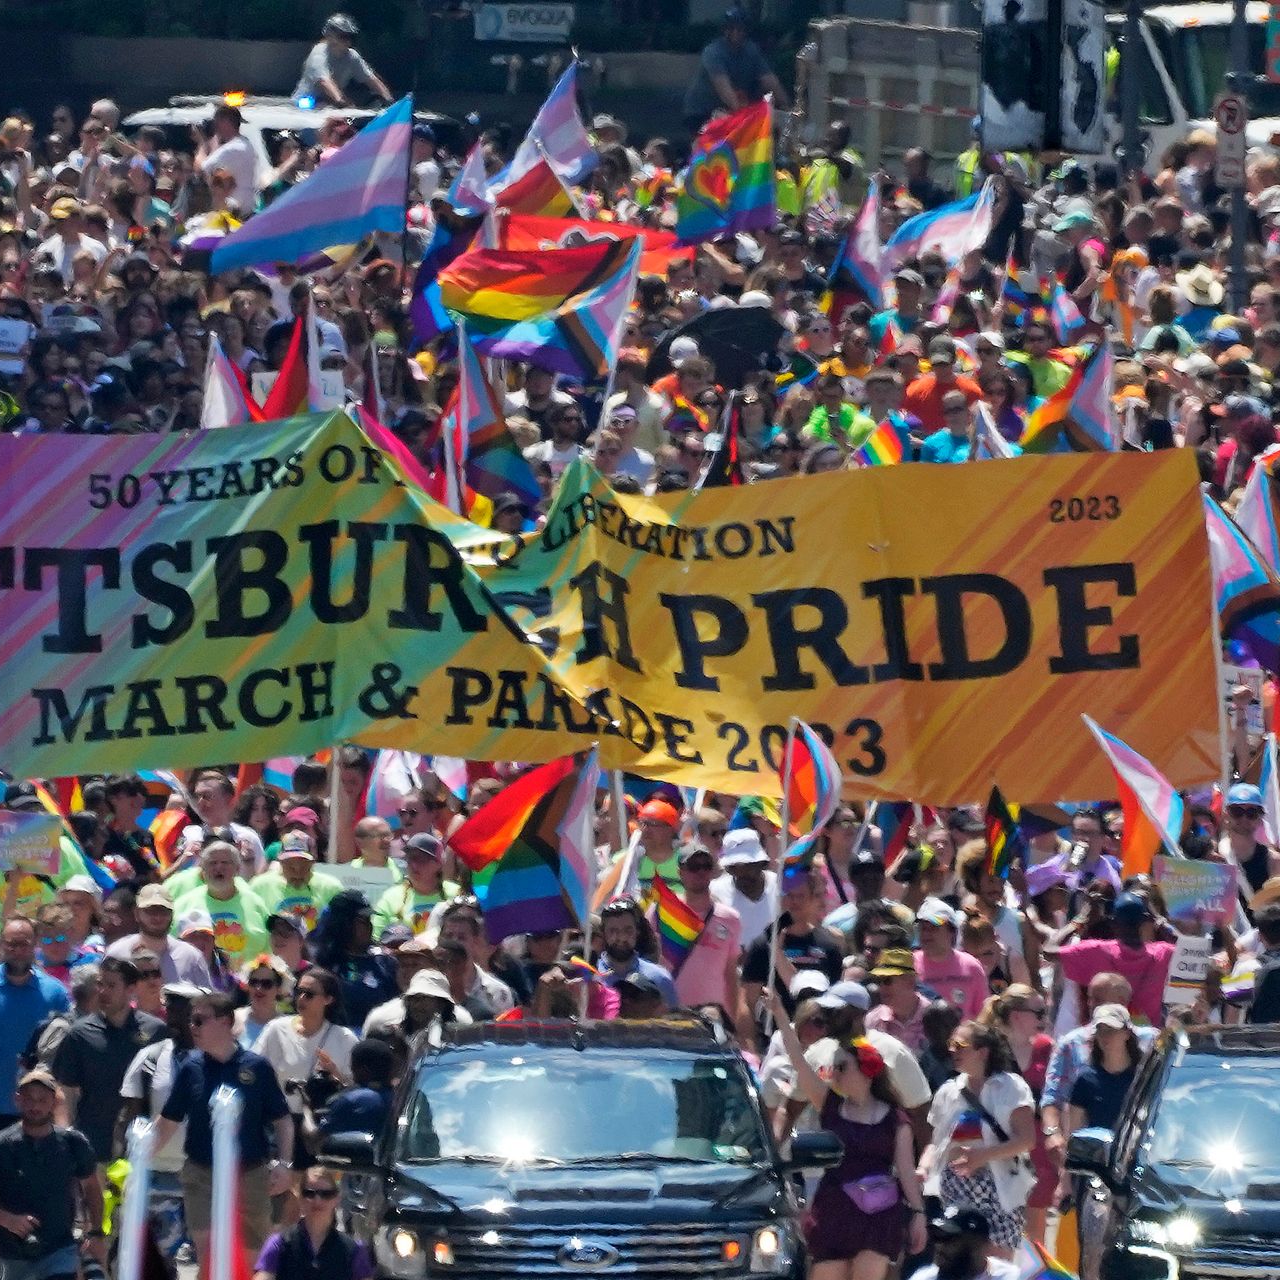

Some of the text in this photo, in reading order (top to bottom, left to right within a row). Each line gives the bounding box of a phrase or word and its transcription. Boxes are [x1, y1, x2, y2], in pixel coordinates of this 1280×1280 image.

[88, 471, 142, 511] 50
[150, 450, 305, 506] YEARS
[540, 491, 797, 563] LIBERATION
[1049, 495, 1122, 524] 2023
[659, 560, 1142, 692] PRIDE
[31, 660, 336, 748] MARCH
[357, 661, 420, 720] &
